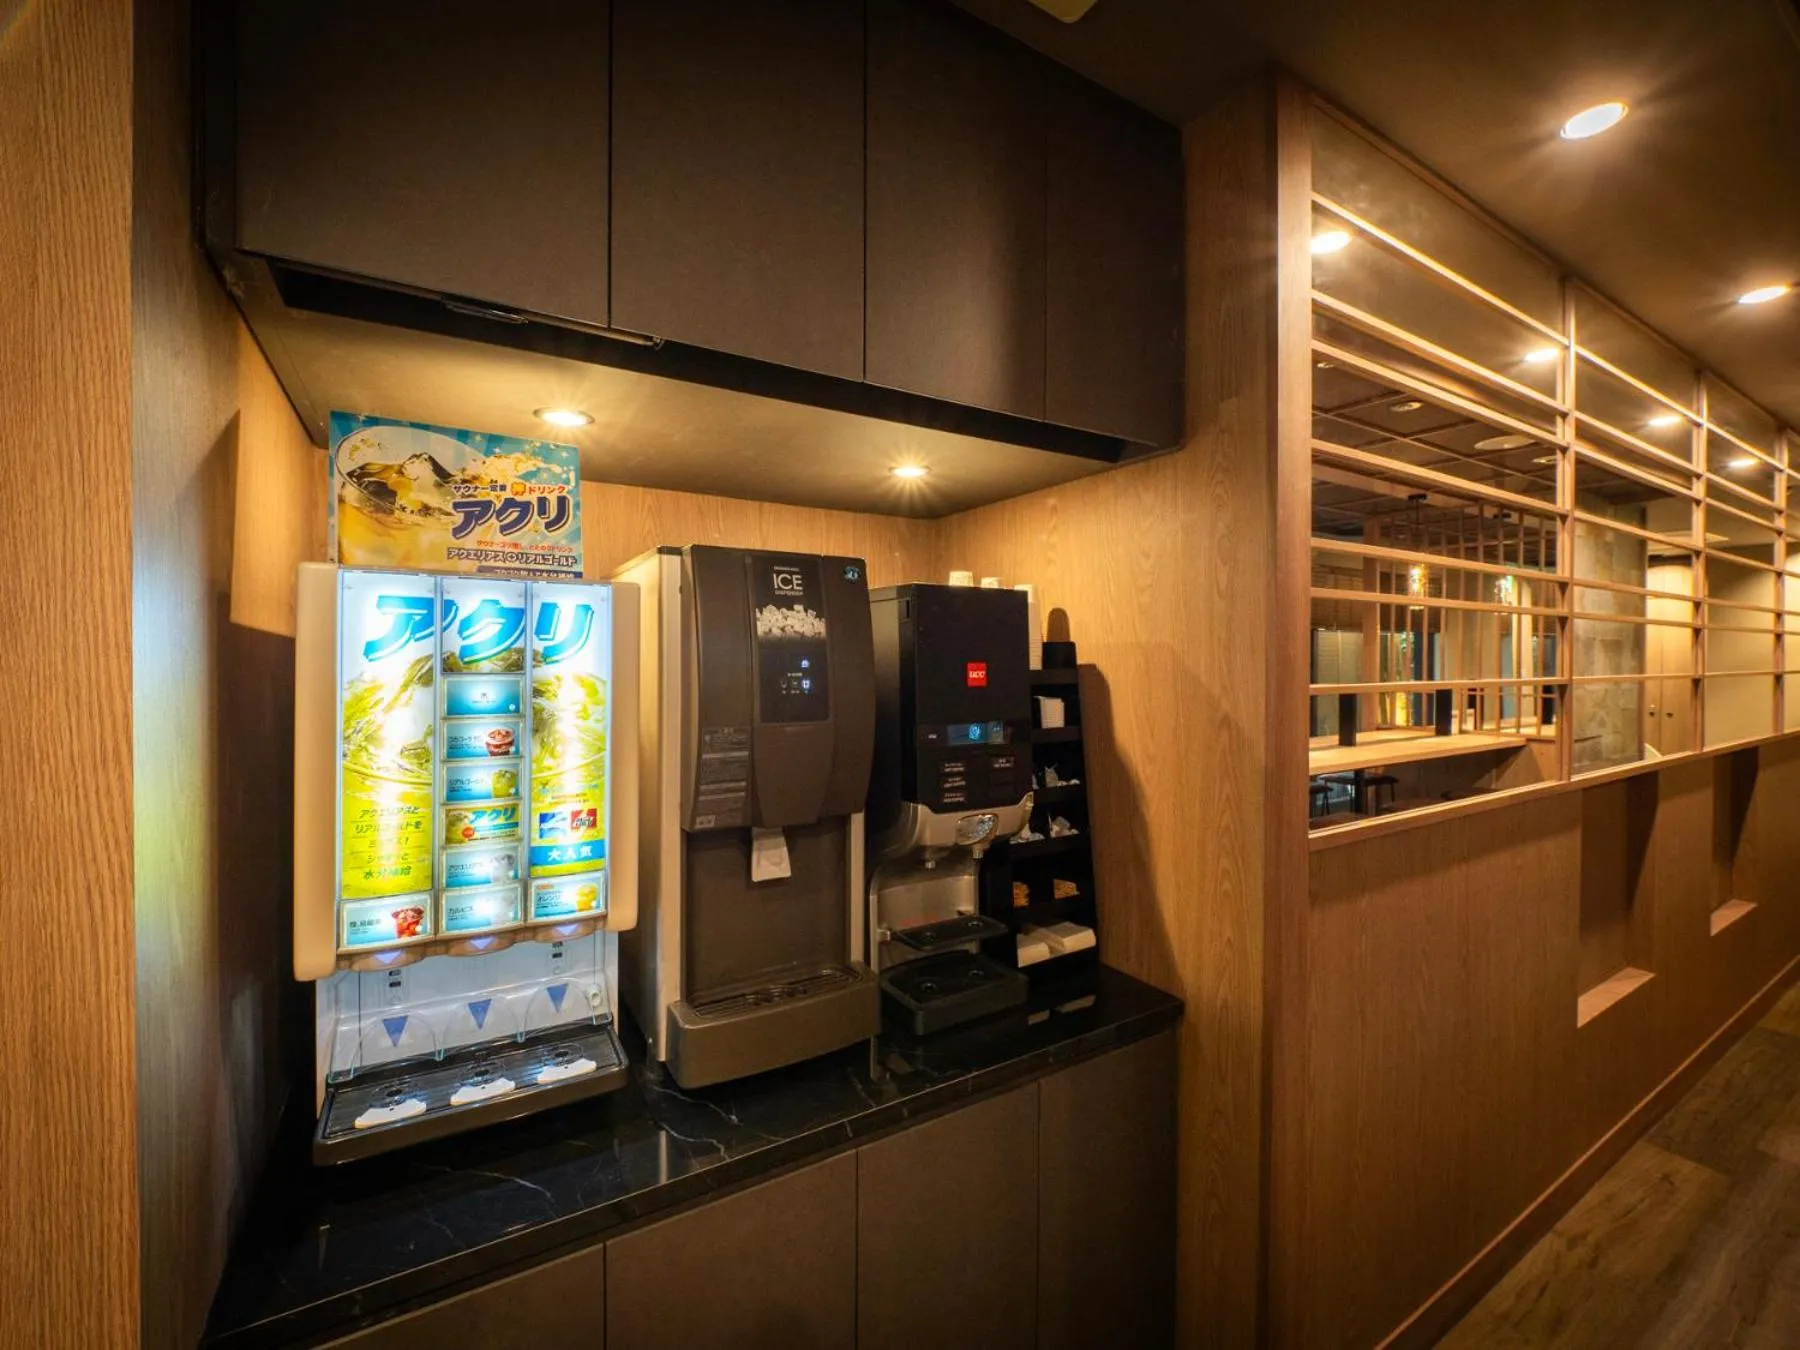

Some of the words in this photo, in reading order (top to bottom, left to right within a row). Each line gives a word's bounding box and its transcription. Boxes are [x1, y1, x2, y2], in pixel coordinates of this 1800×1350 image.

[451, 495, 570, 540] アクリ
[773, 573, 804, 590] ICE
[362, 595, 595, 666] アクリ
[468, 805, 517, 825] アクリ
[547, 845, 594, 863] 大人気
